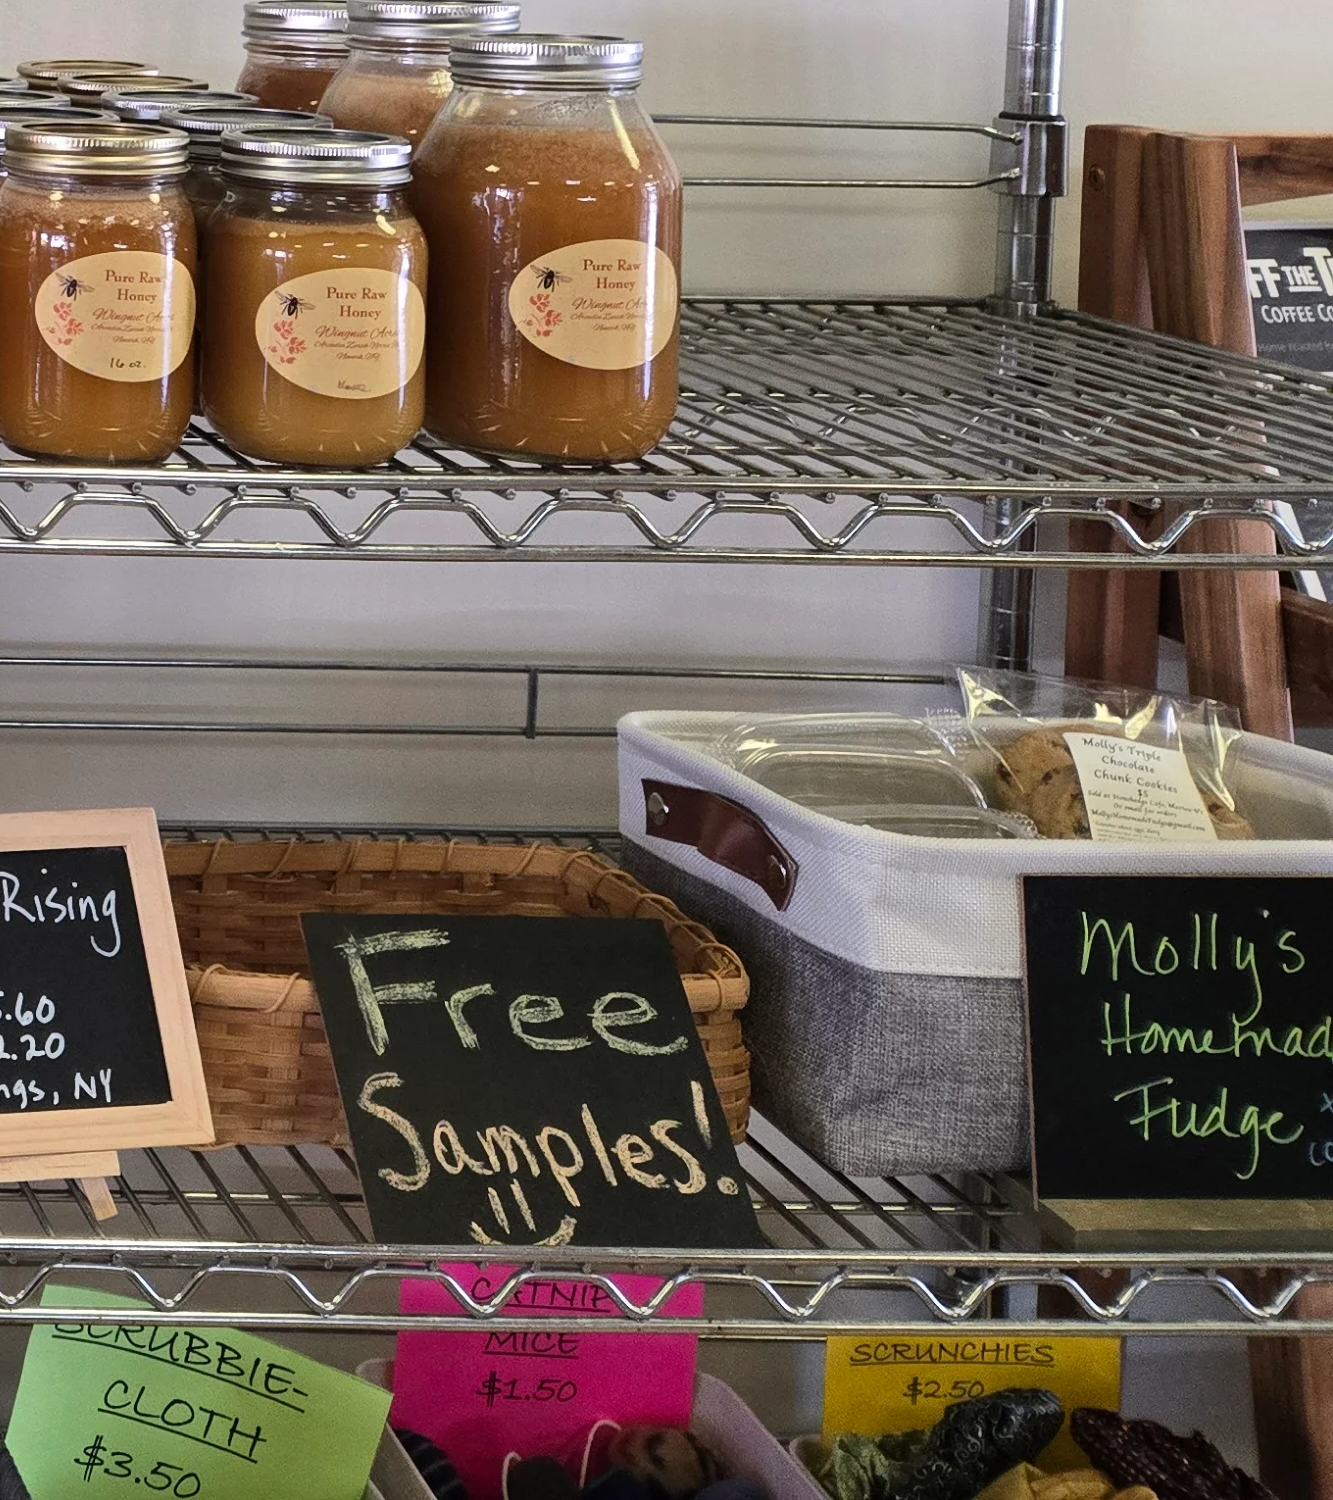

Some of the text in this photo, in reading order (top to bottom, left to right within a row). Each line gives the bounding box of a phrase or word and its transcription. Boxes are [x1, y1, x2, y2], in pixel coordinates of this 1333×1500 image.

[105, 270, 162, 284] Pure Raw
[583, 258, 642, 272] Pure Raw
[1281, 265, 1319, 286] THE
[117, 288, 157, 304] Honey
[327, 286, 388, 300] Pure Raw
[596, 276, 637, 292] Honey
[339, 304, 382, 320] Honey
[1261, 304, 1316, 324] COFFEE
[110, 358, 125, 369] 16
[1083, 738, 1161, 762] Molly's Triple
[1101, 756, 1155, 774] Chocolate
[1094, 769, 1177, 794] Chunk Cookies
[1080, 909, 1306, 1025] Molly's
[333, 928, 689, 1055] Free
[1100, 993, 1333, 1059] Homemad
[73, 1068, 113, 1104] NY
[357, 1070, 740, 1208] Samples!
[1114, 1076, 1304, 1180] Fudge
[471, 1277, 612, 1309] CTNIP
[483, 1329, 579, 1357] MICE
[850, 1342, 1055, 1365] SCRUNCHIES
[475, 1370, 578, 1407] $1.50
[902, 1376, 985, 1405] $2.50
[103, 1380, 268, 1455] CLOTH
[73, 1434, 201, 1499] $3.50
